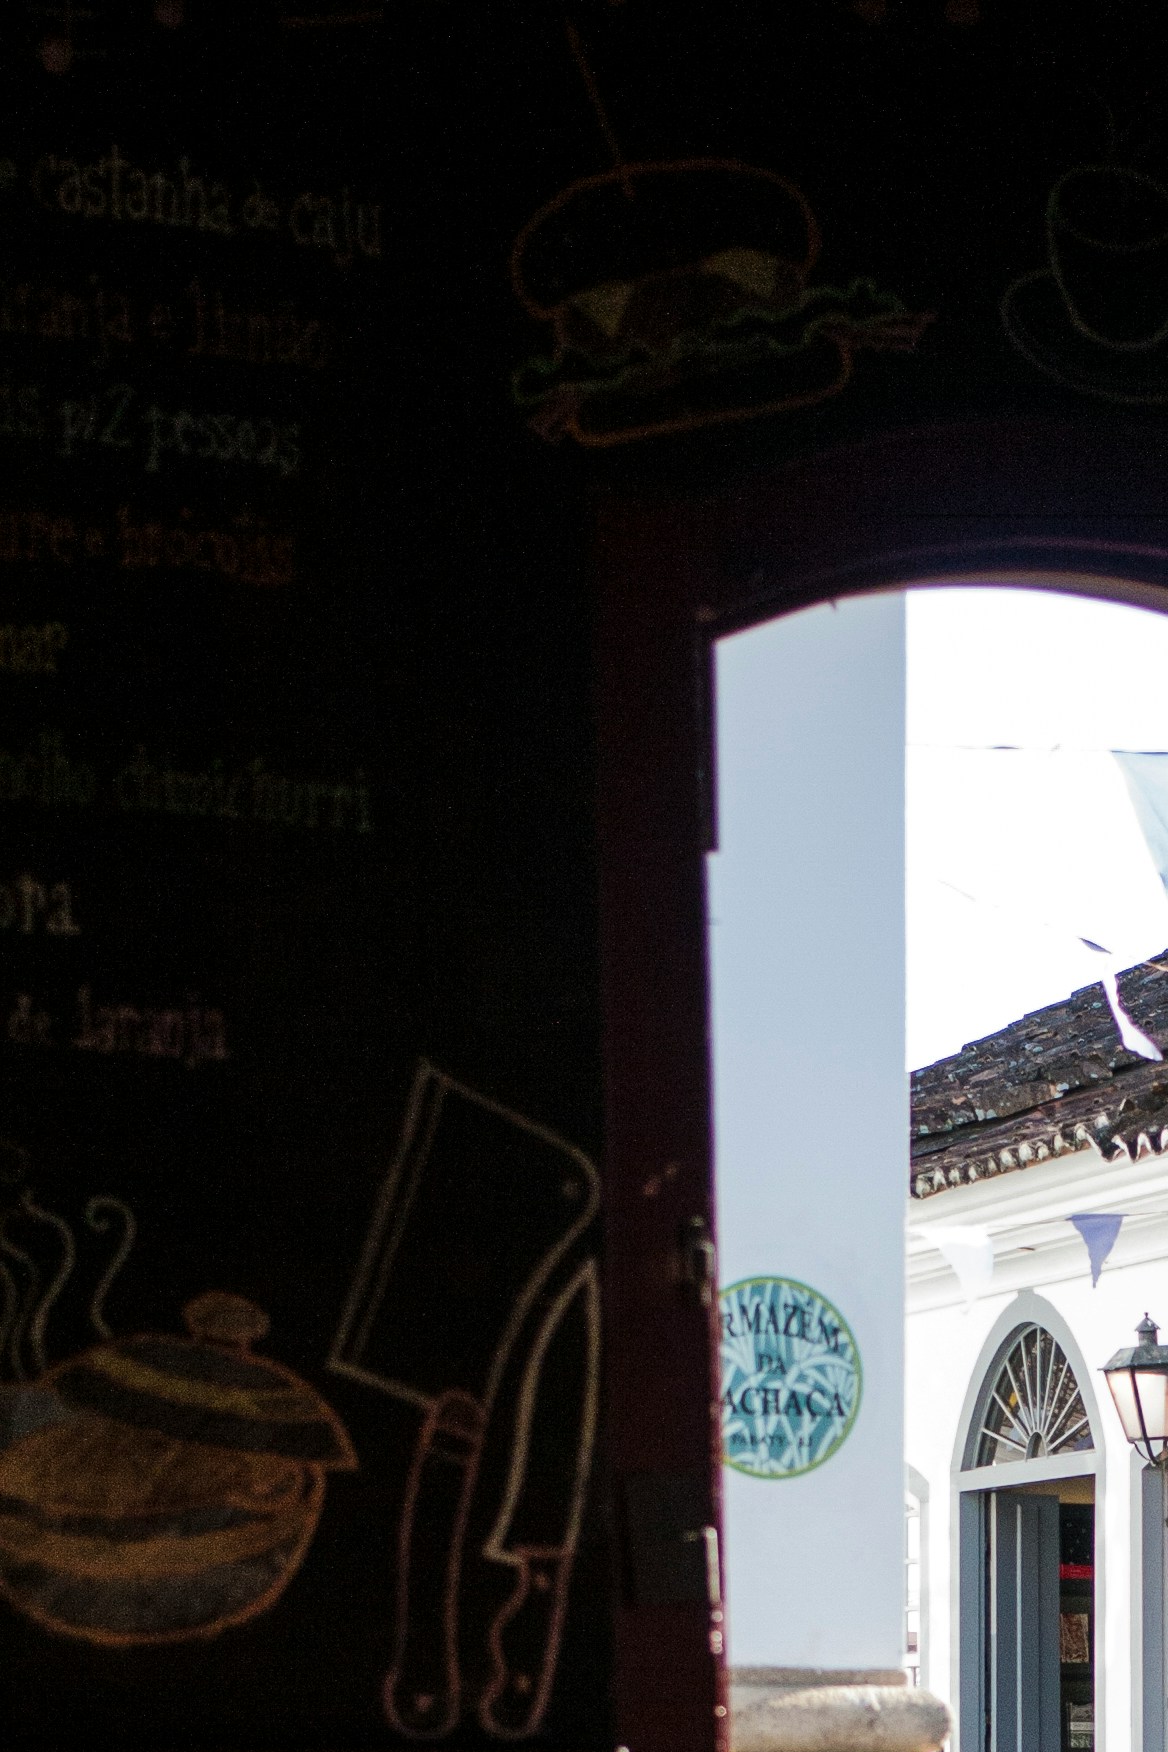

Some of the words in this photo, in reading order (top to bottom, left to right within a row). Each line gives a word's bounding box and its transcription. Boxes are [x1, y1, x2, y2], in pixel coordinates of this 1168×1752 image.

[29, 143, 238, 240] castanha
[287, 186, 386, 273] caju
[140, 403, 304, 478] pessoas
[70, 983, 233, 1070] laranja
[757, 1353, 787, 1374] DA
